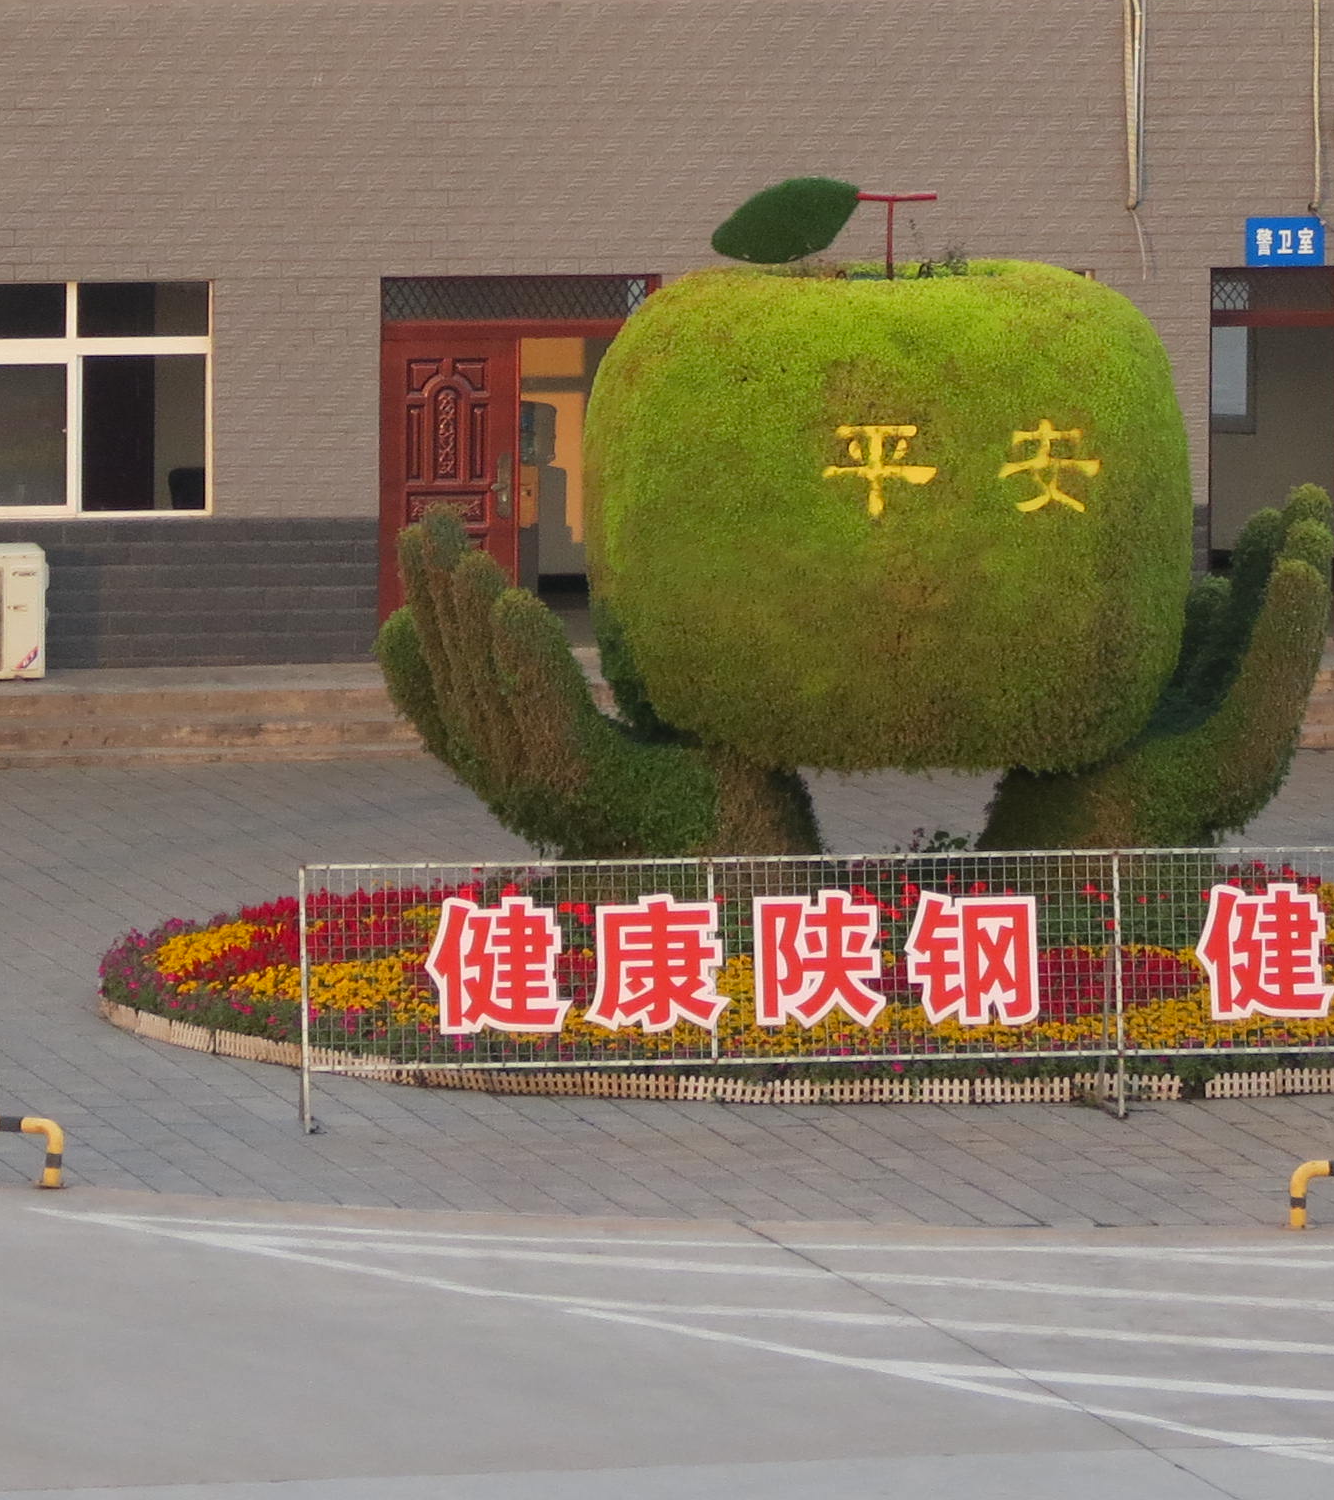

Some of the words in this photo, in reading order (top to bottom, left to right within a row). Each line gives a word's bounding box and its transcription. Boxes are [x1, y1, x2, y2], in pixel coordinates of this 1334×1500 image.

[1256, 227, 1315, 256] 警卫室
[822, 418, 1101, 517] 平安
[427, 892, 1039, 1034] 健康陕钢
